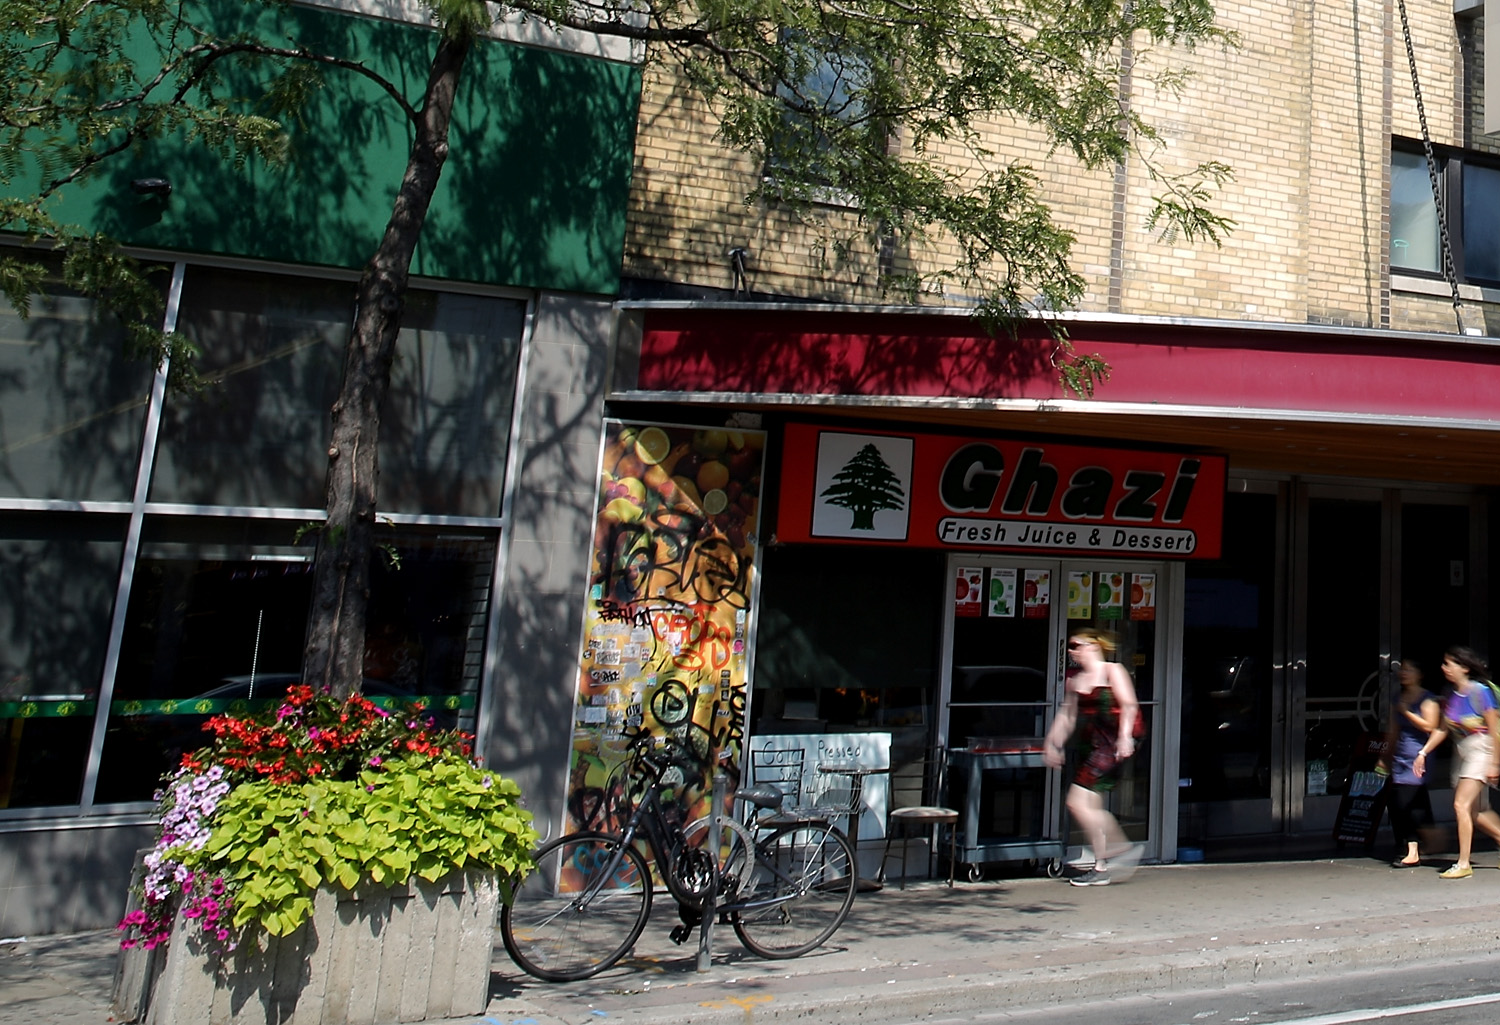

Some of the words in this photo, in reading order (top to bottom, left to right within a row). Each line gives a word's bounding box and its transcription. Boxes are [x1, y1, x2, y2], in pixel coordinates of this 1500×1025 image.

[938, 442, 1201, 523] Ghazi
[941, 522, 1006, 542] Fresh
[1018, 525, 1077, 545] Juice
[1088, 529, 1101, 546] &
[1112, 529, 1194, 551] Dessert
[763, 740, 801, 764] Cold
[818, 739, 861, 762] Pressed
[1310, 763, 1325, 772] PASS
